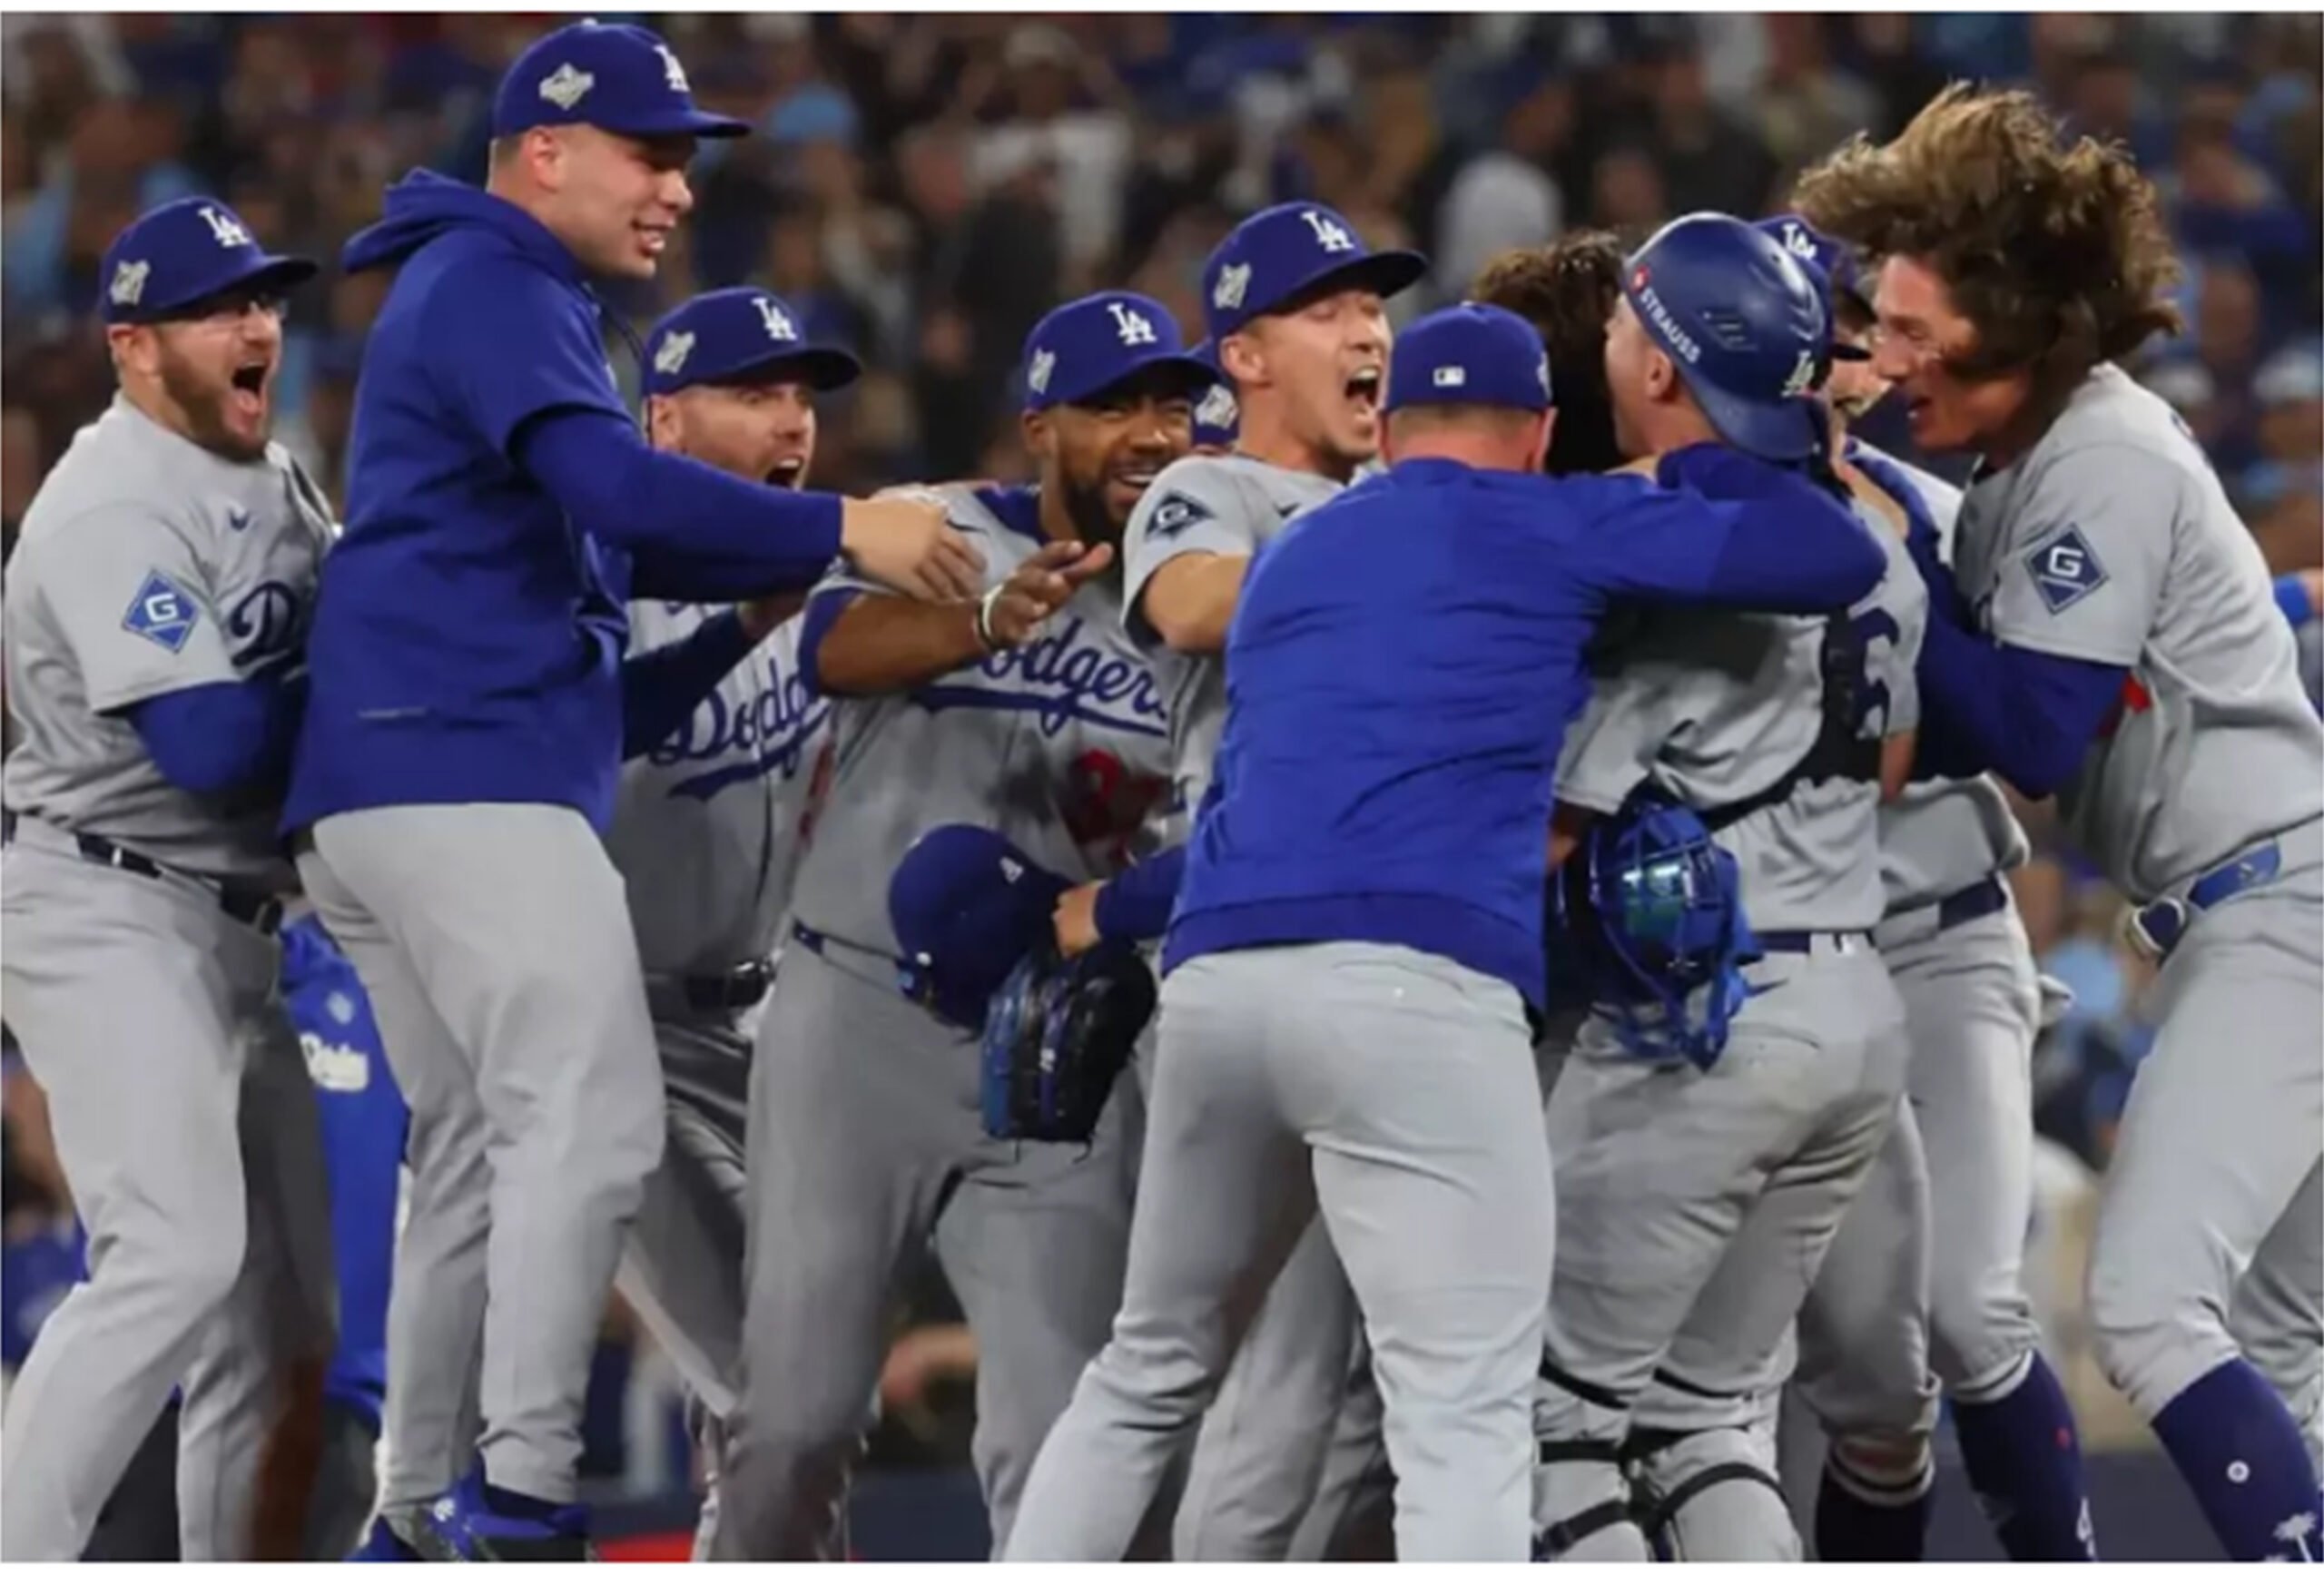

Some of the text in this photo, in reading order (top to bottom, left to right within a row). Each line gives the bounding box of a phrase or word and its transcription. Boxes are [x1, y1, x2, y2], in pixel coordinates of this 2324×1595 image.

[198, 207, 250, 247] LA
[1301, 212, 1354, 251] LA
[752, 298, 797, 340] LA
[1108, 302, 1157, 346] LA
[1640, 287, 1701, 363] STRAUSS
[2049, 546, 2083, 578] G
[144, 592, 179, 623] G
[982, 616, 1167, 738] odger
[648, 656, 810, 781] Dodg
